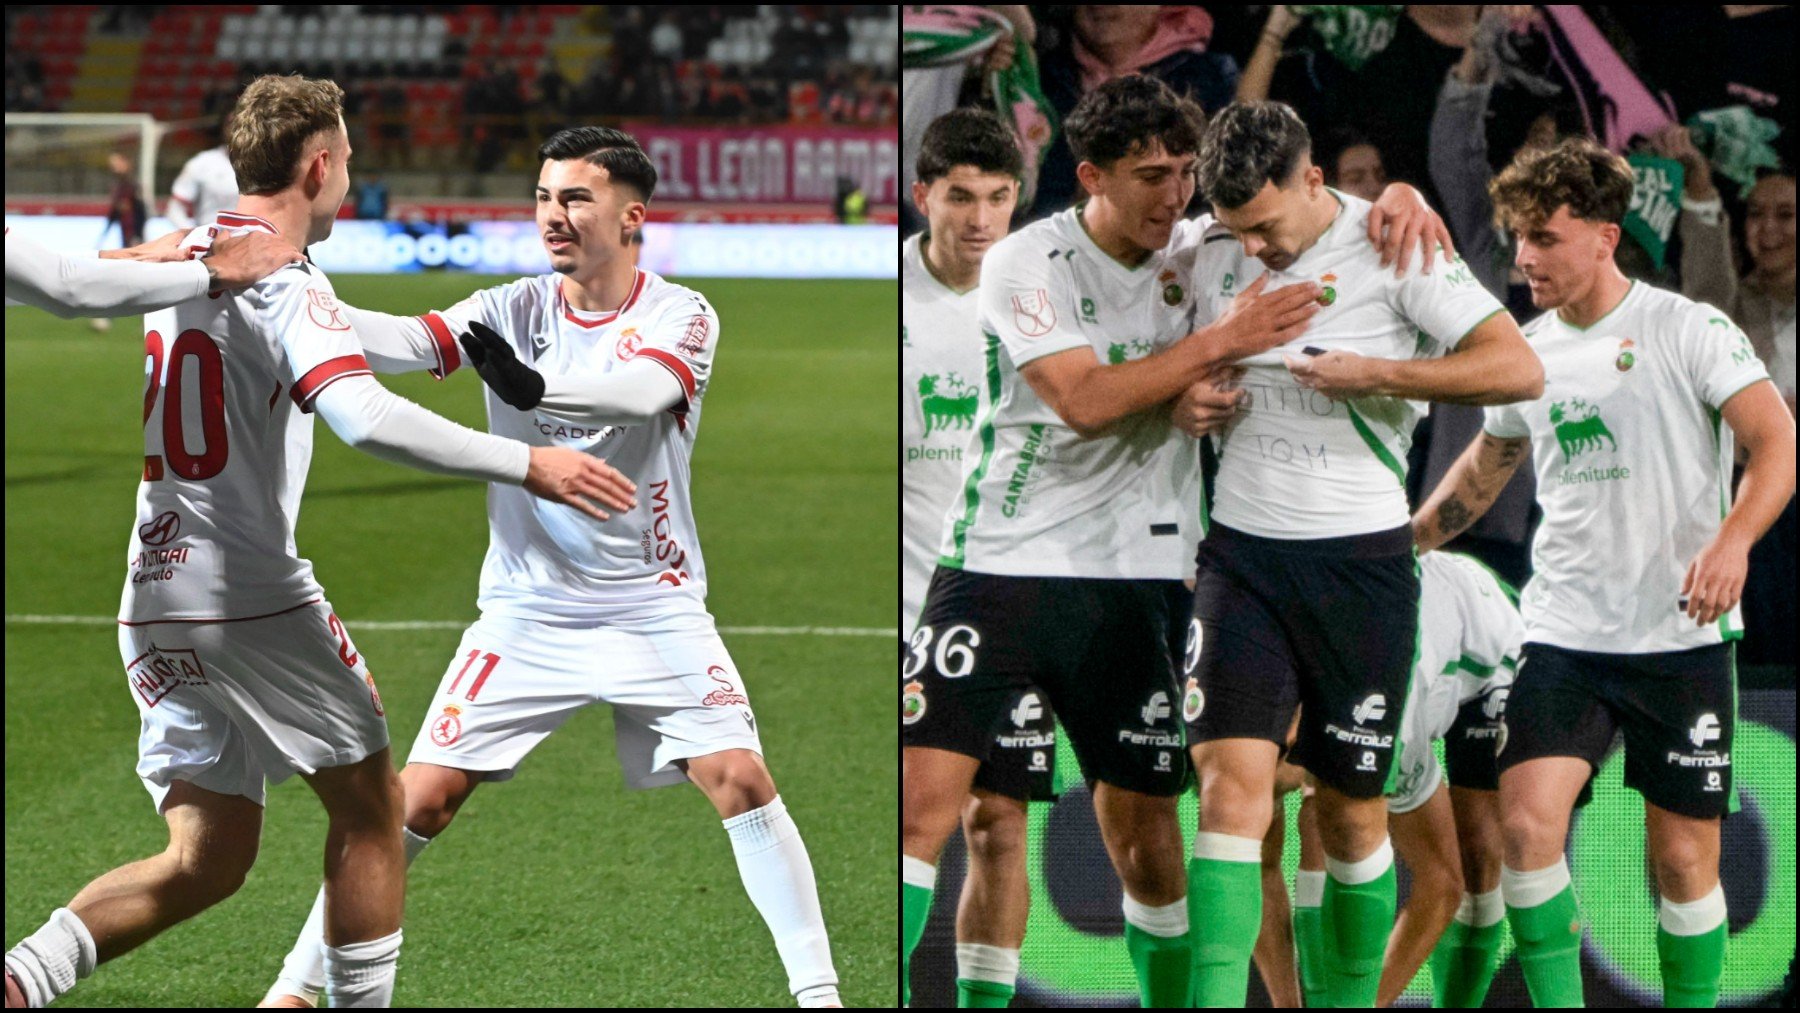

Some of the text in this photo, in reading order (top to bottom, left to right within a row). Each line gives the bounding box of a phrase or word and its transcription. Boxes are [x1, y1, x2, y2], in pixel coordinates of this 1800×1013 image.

[794, 138, 897, 200] RAMP
[143, 329, 229, 482] 20
[534, 418, 628, 440] ACADEMY
[907, 444, 963, 462] plenit
[1002, 423, 1046, 518] CANTABRIA
[1558, 464, 1631, 486] plenitude
[649, 480, 677, 562] MGS
[446, 648, 502, 702] 11
[1466, 727, 1497, 739] Ferr
